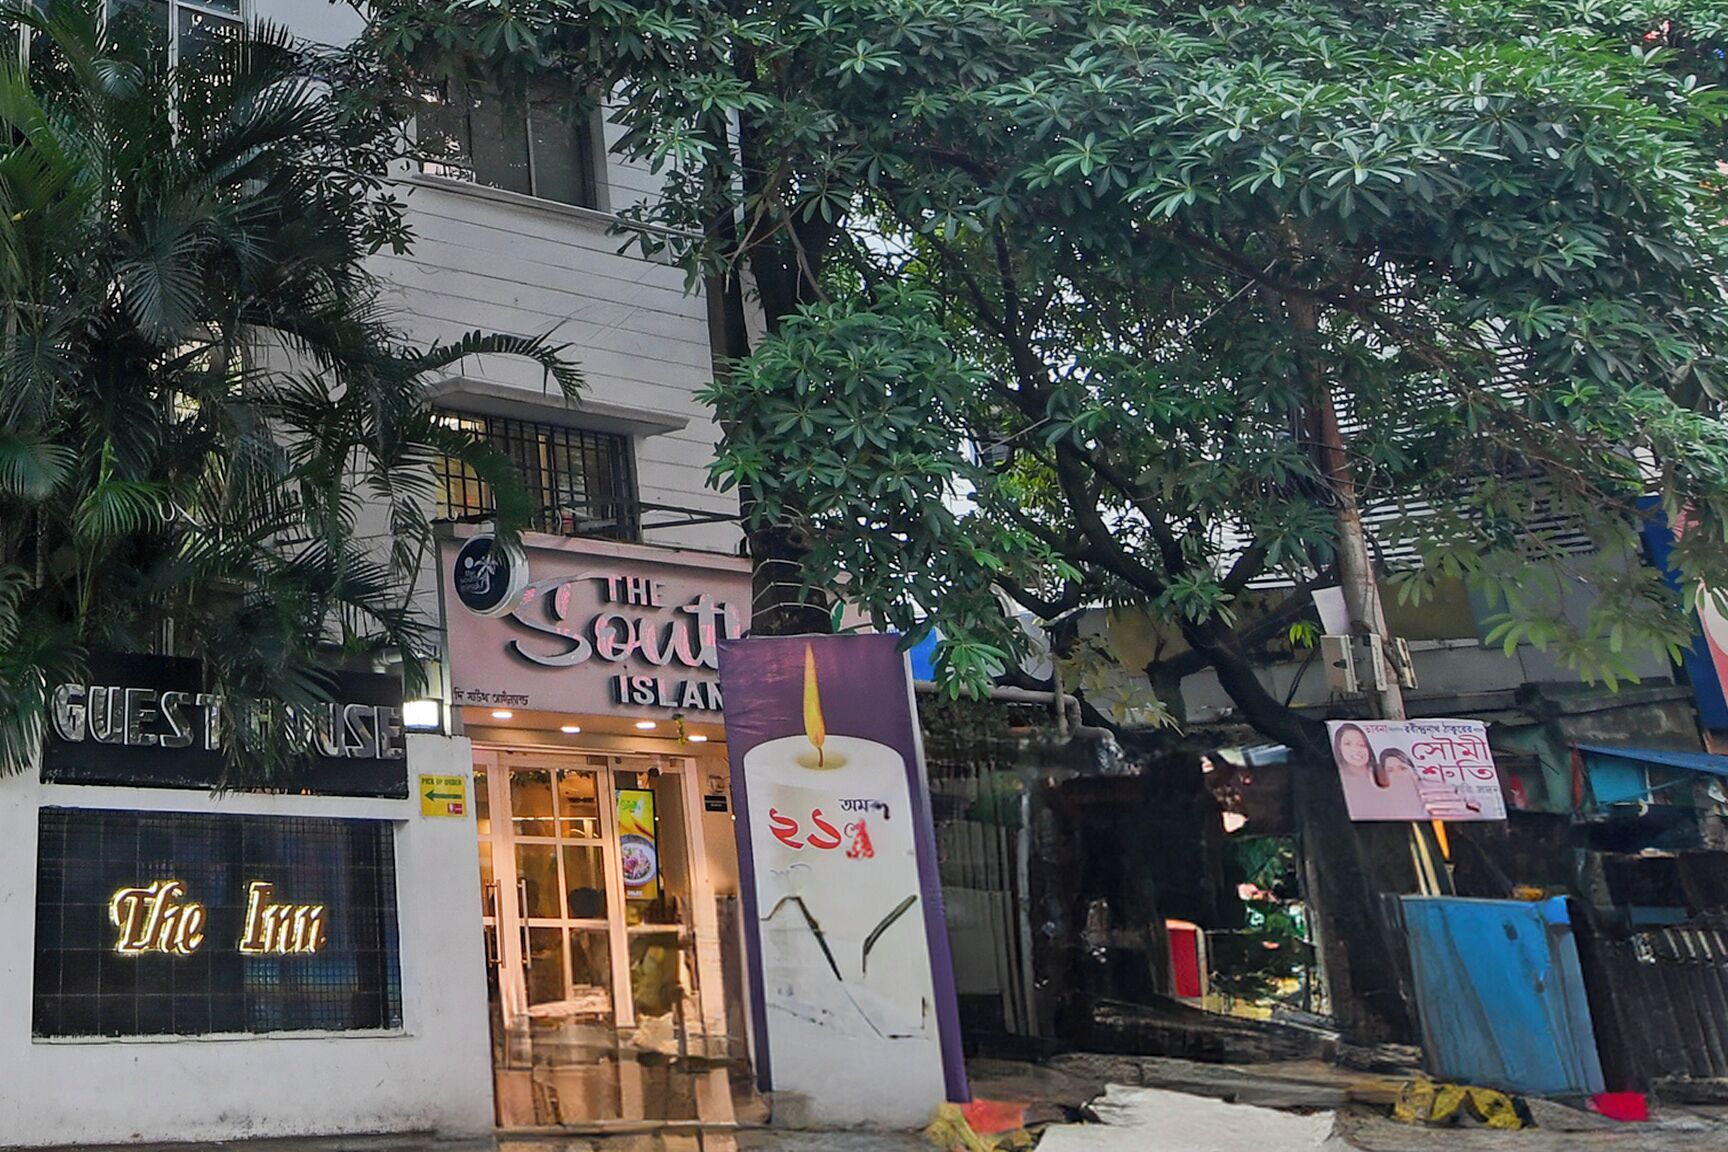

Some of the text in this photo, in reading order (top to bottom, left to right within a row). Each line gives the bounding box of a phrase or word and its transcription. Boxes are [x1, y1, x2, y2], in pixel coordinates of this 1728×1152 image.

[606, 574, 669, 607] THE
[50, 682, 225, 751] GUEST
[618, 674, 725, 711] ISLAN
[109, 879, 327, 956] The Inn
